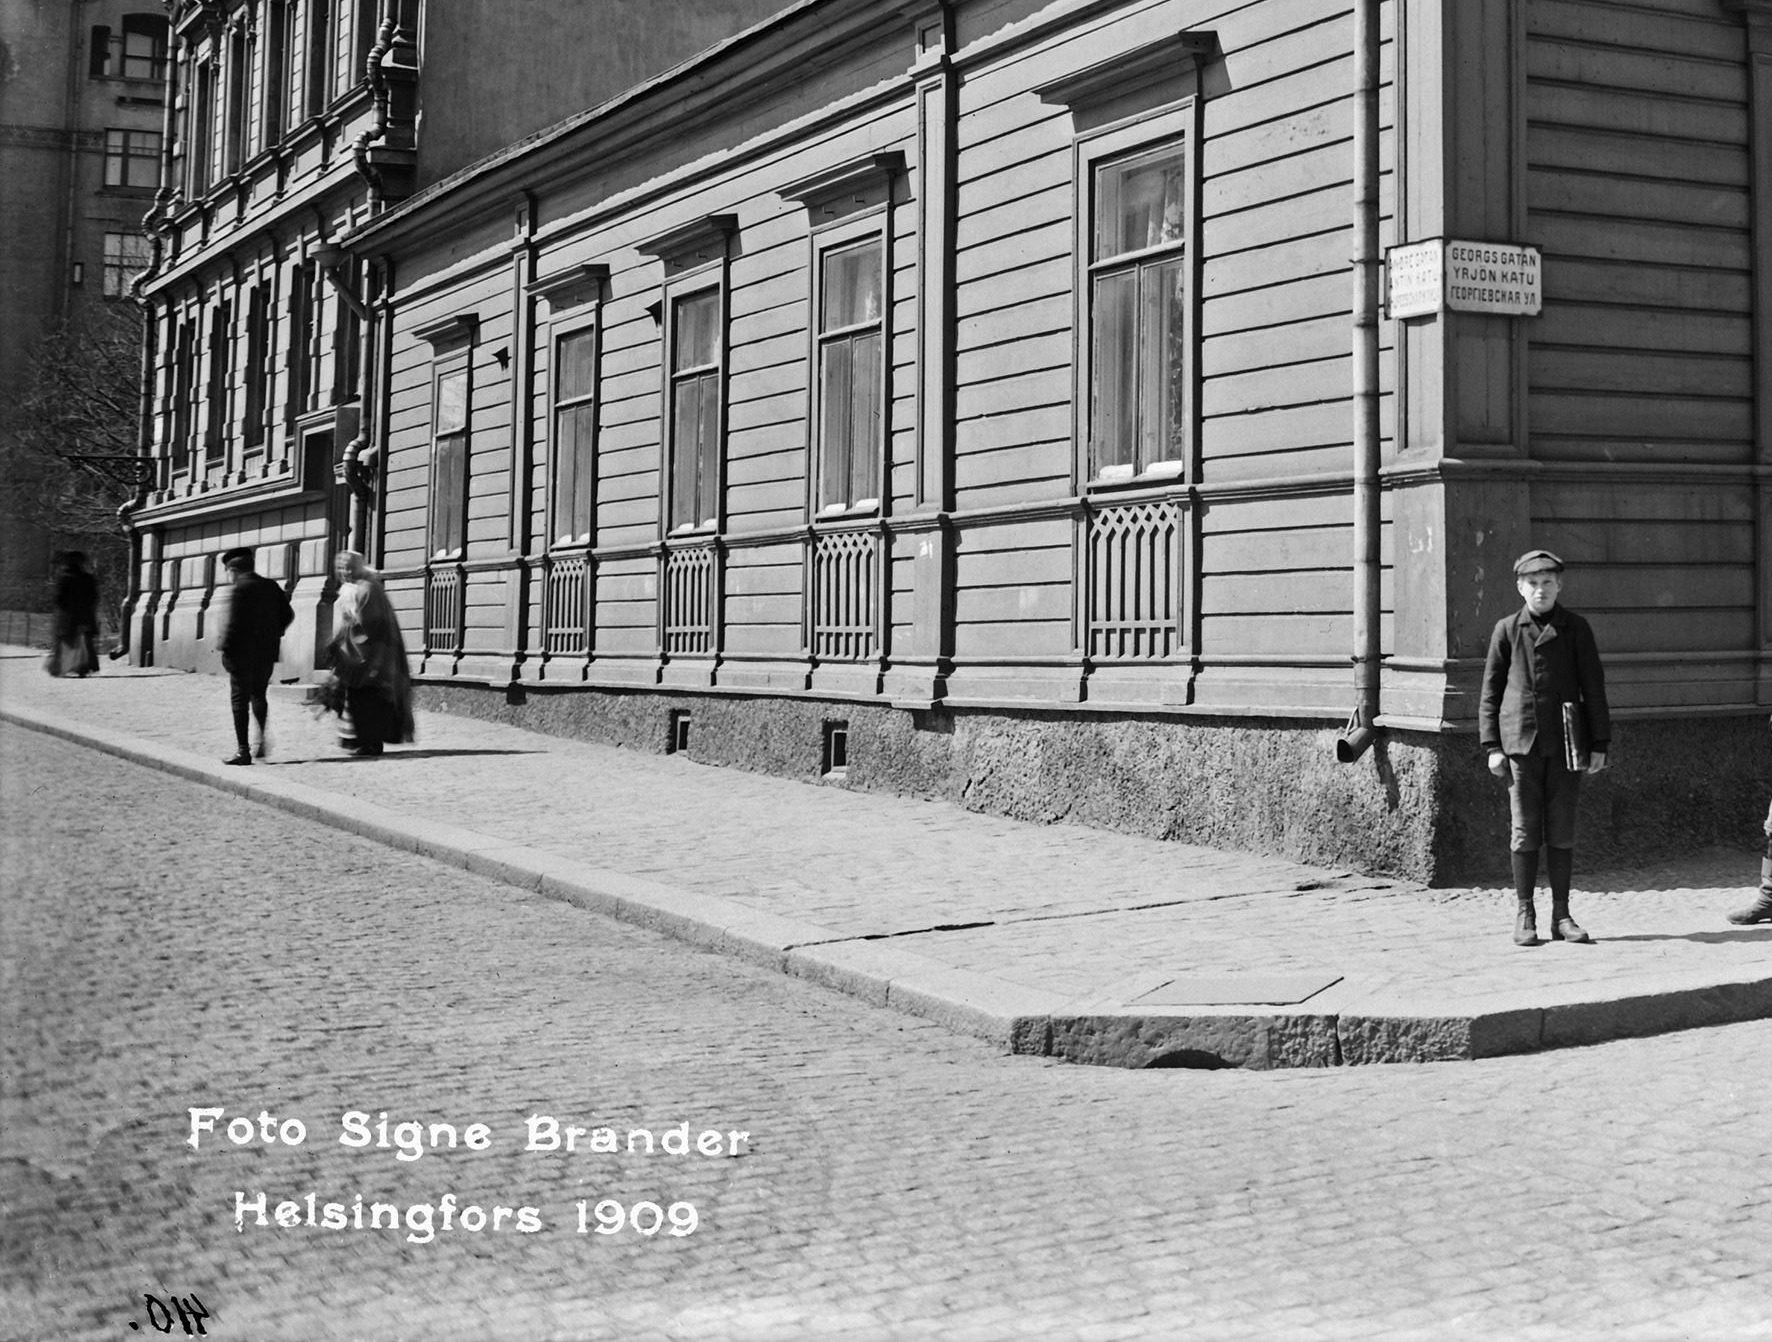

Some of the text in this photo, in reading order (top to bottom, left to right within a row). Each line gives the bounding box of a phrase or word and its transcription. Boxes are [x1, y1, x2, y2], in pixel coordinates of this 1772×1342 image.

[1452, 247, 1536, 267] GEORGS GATAN
[1453, 264, 1534, 285] YRJÖN KATU
